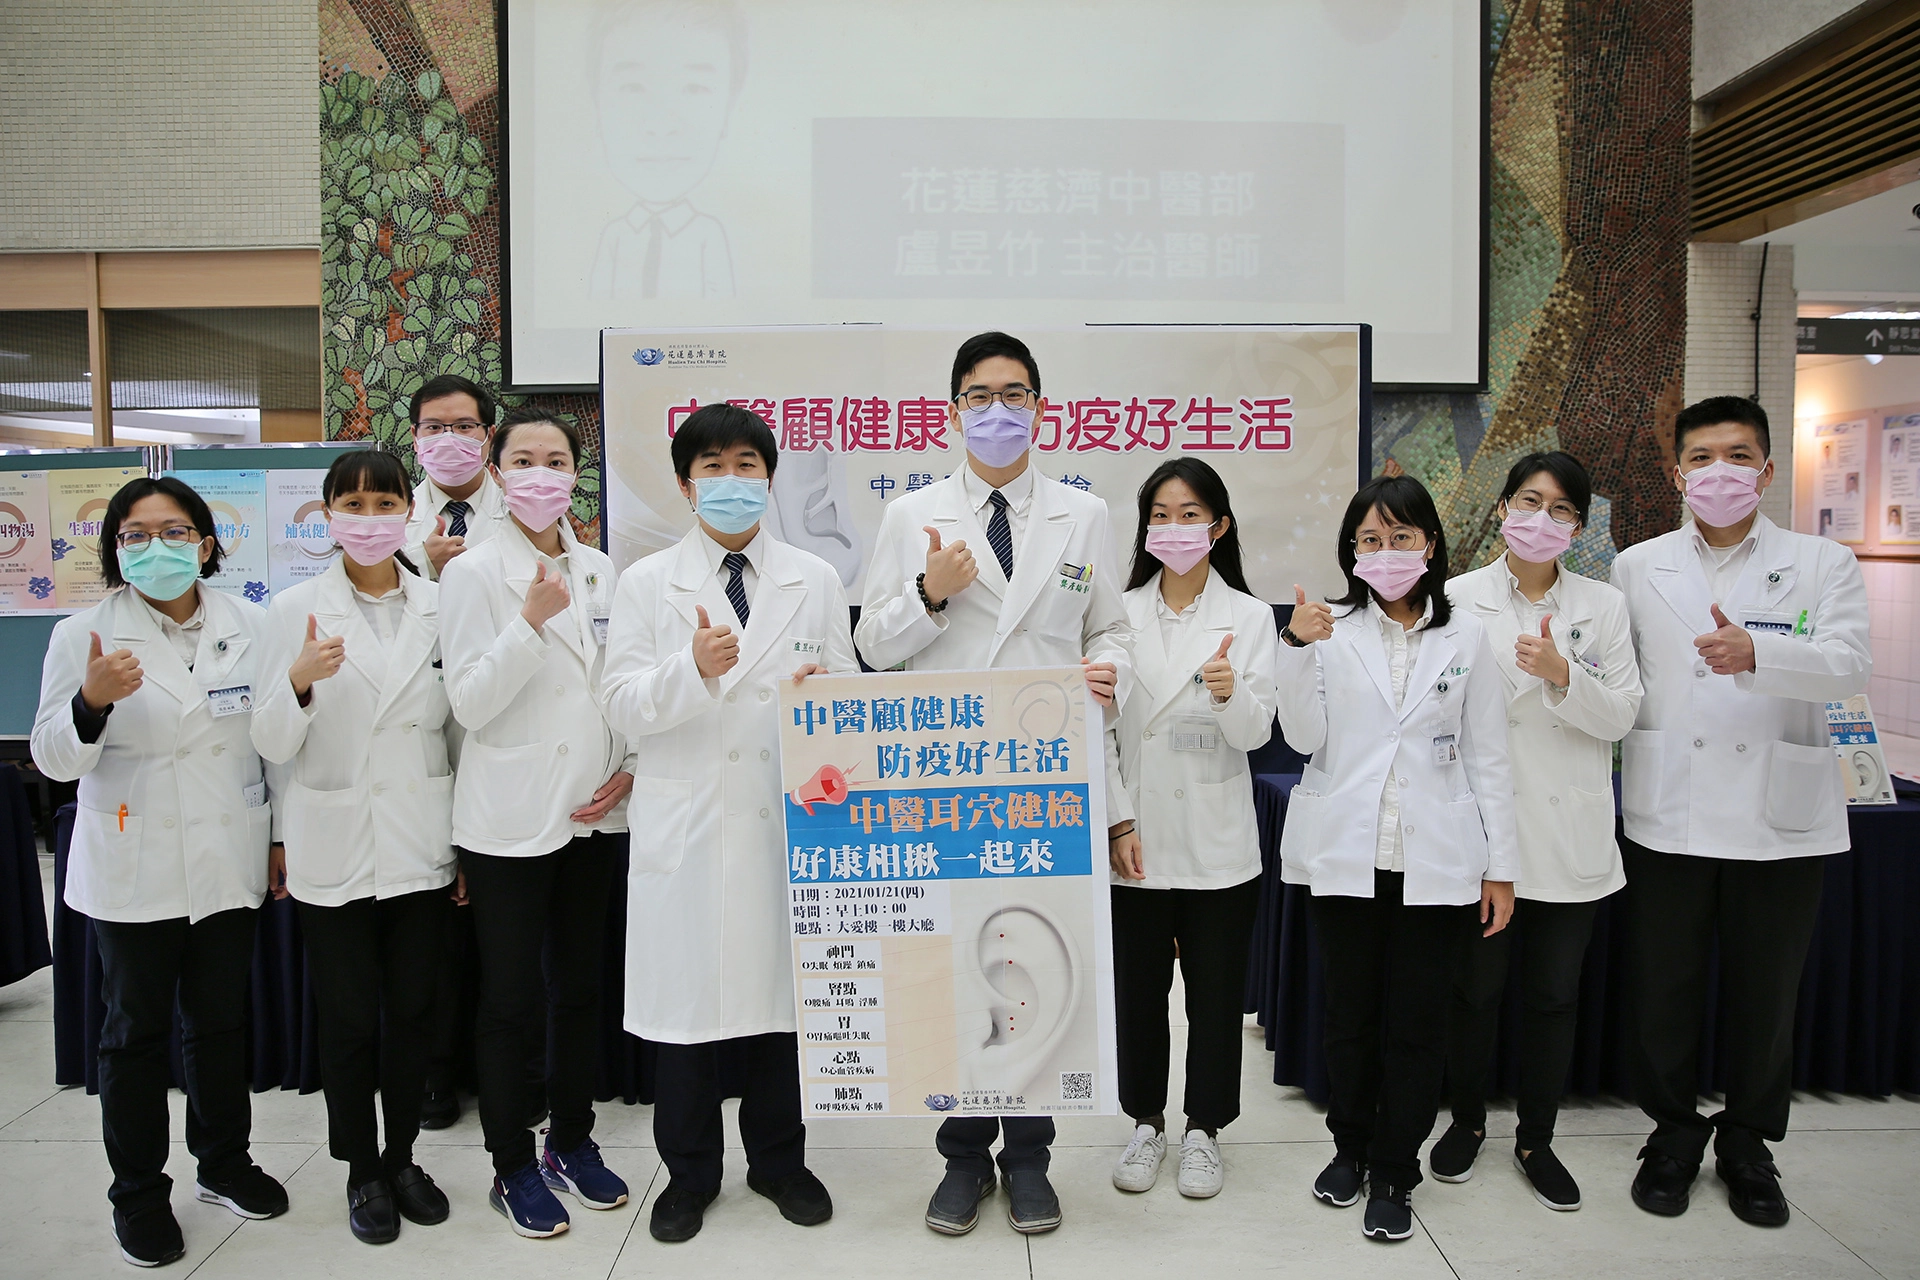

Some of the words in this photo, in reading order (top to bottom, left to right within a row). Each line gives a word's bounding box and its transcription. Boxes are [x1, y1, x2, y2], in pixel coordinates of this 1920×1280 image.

[900, 166, 1256, 217] 花蓮慈濟中醫部
[894, 228, 1044, 278] 盧昱竹
[1060, 230, 1263, 280] 主治醫師
[668, 349, 727, 359] 花蓮慈濟醫院
[793, 693, 986, 736] 中醫顧健康
[877, 736, 1070, 779] 防疫好生活
[850, 790, 1085, 834] 中醫耳穴健檢
[791, 838, 1054, 881] 好康相揪一起來
[826, 945, 855, 959] 神門
[828, 982, 857, 996] 腎點
[838, 1015, 851, 1029] 胃
[832, 1050, 861, 1064] 心點
[834, 1087, 863, 1101] 肺點
[962, 1095, 1026, 1105] 花蓮慈濟醫院
[865, 1101, 883, 1111] 水腫
